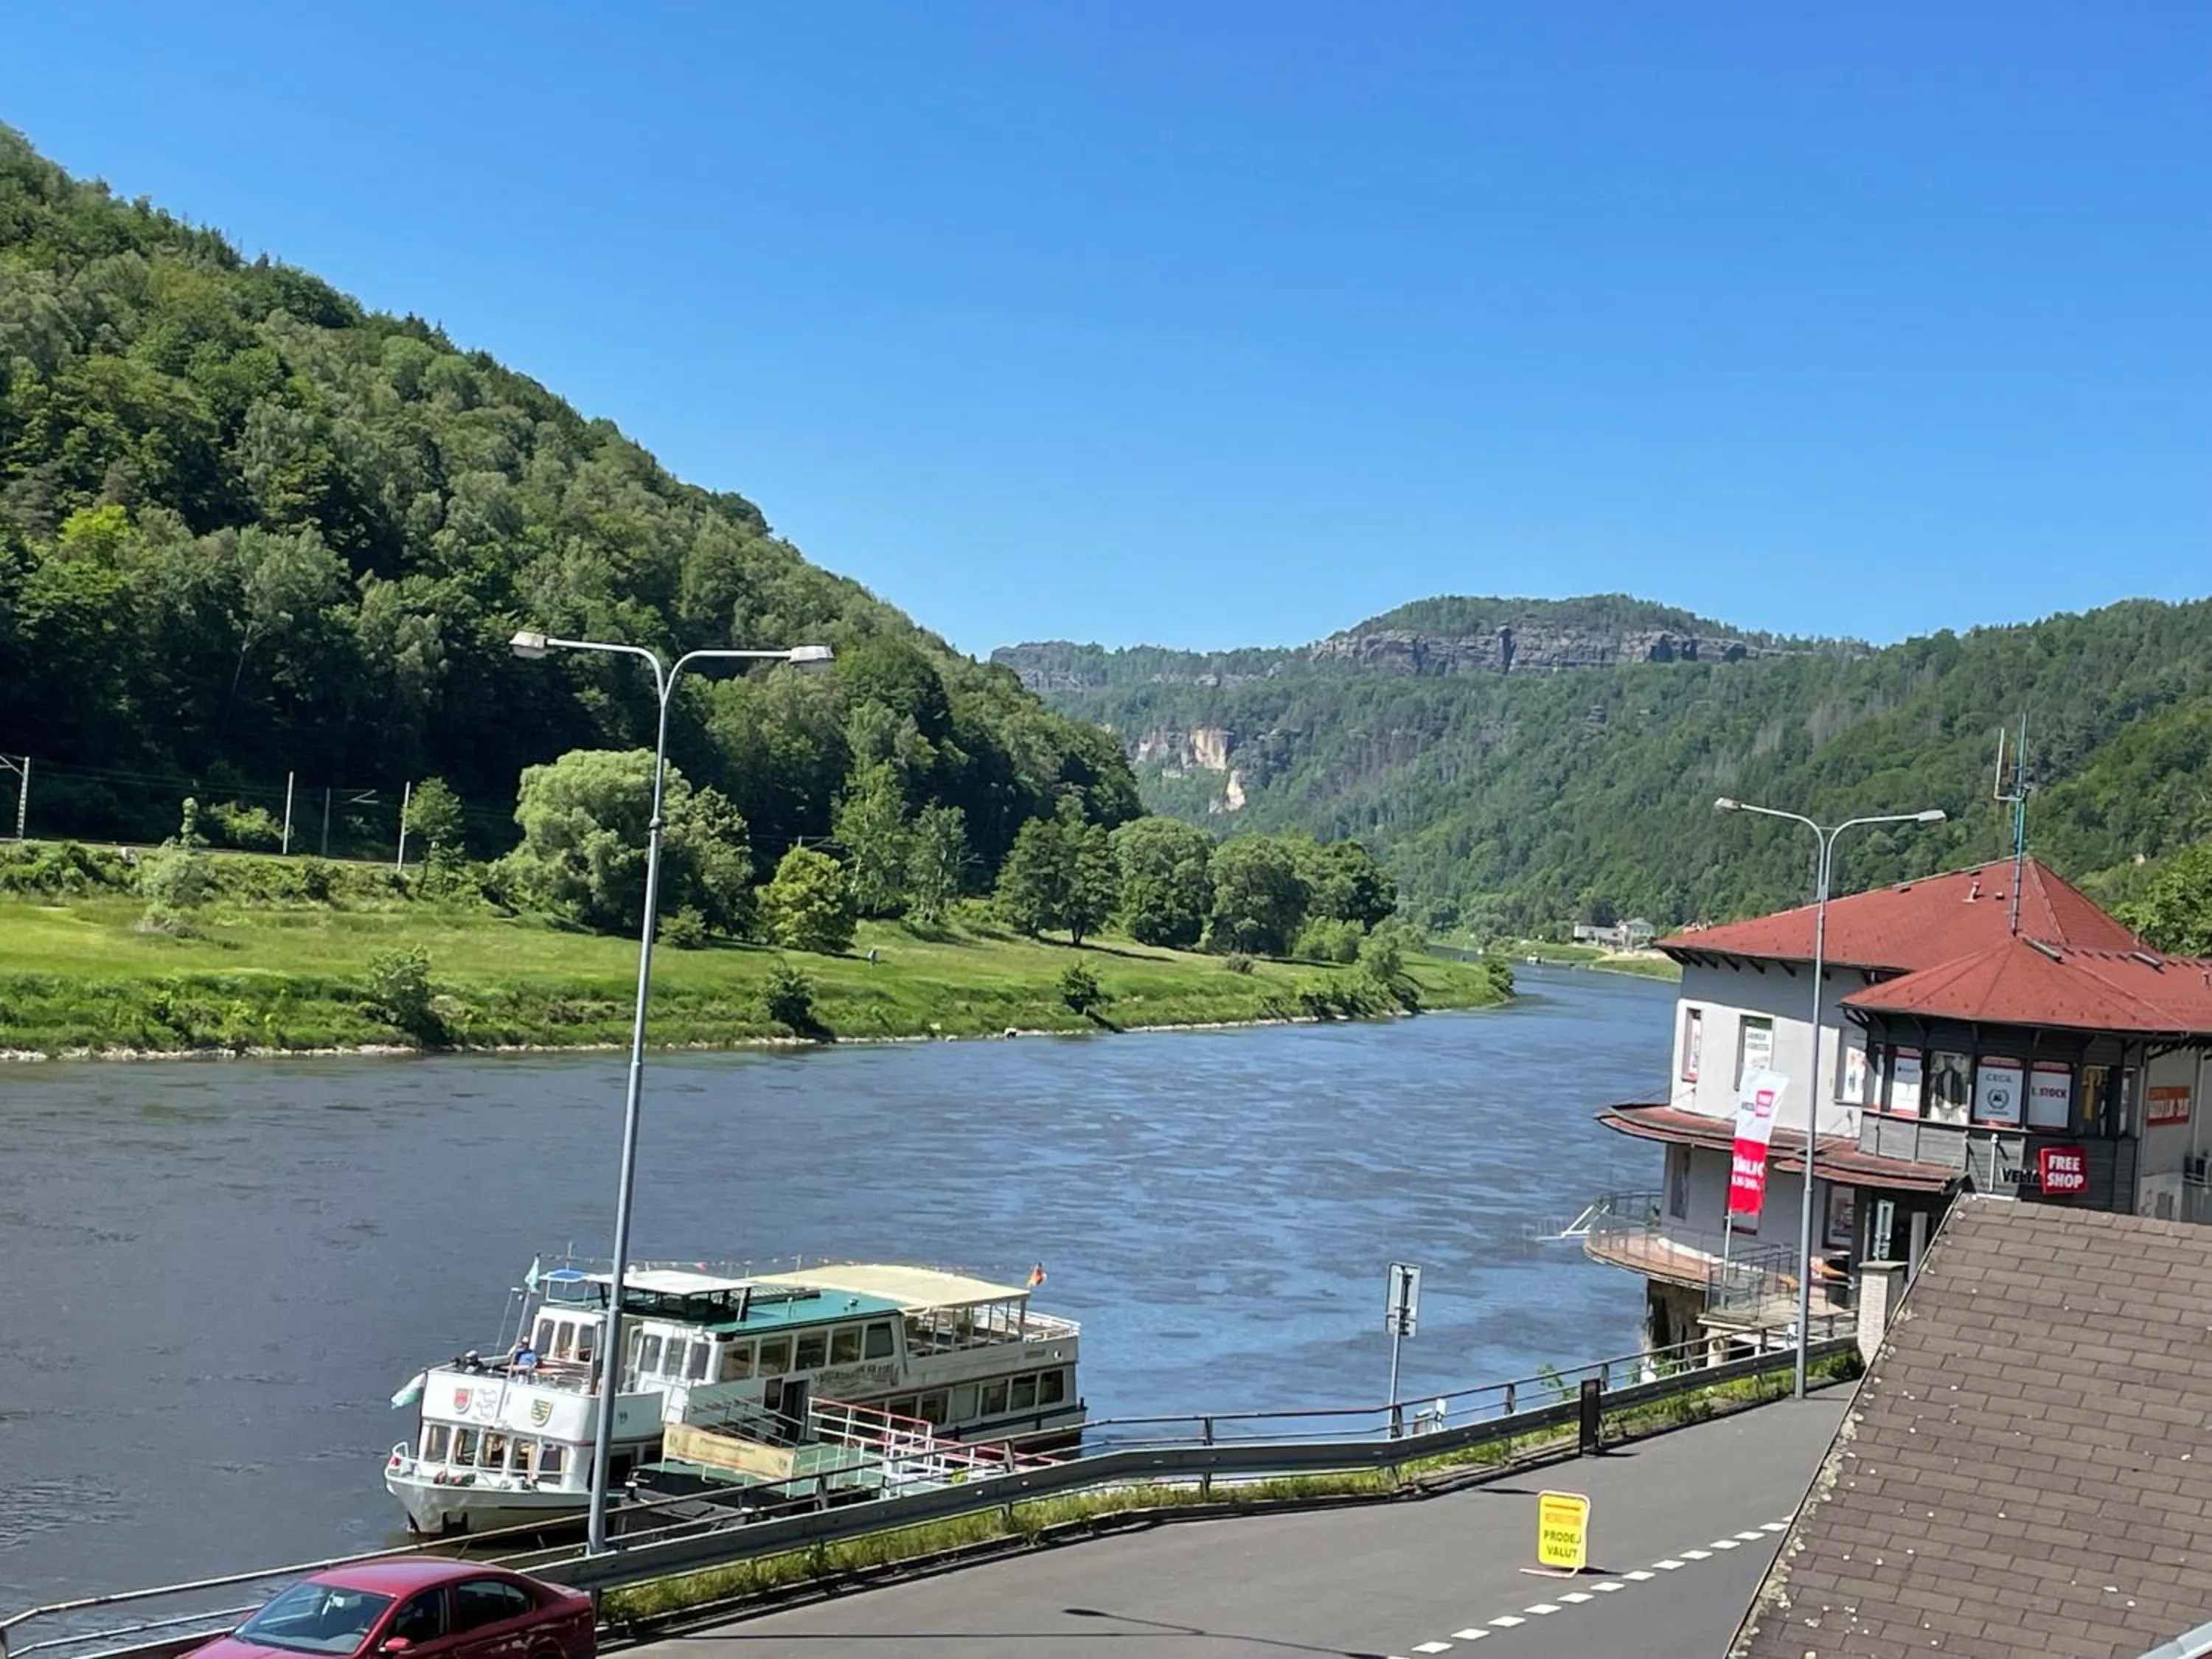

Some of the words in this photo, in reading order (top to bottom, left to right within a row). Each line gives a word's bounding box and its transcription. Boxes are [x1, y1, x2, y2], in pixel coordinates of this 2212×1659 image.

[2048, 1155, 2081, 1171] FREE
[2046, 1172, 2084, 1189] SHOP
[1543, 1529, 1582, 1545] PRODEJ
[1546, 1545, 1578, 1558] VALUT
